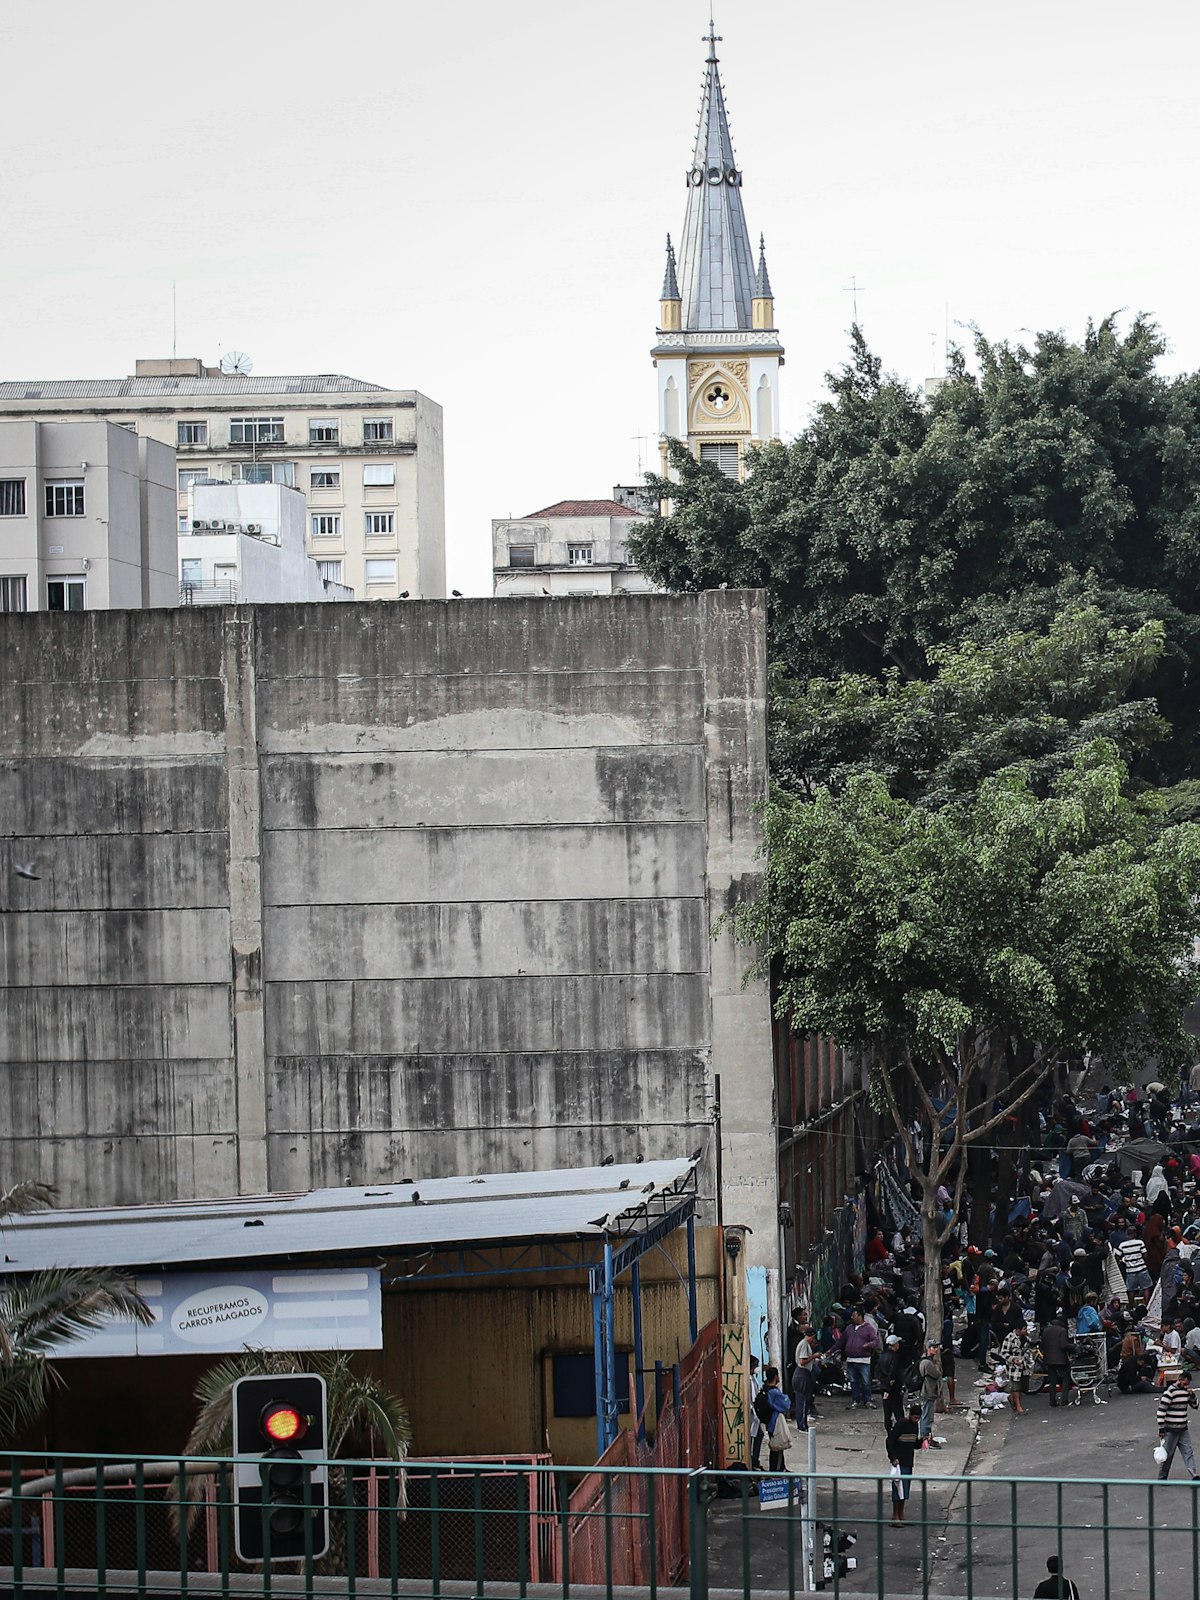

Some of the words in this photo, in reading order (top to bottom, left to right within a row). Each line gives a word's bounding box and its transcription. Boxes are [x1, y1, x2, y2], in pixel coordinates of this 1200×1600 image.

[179, 1317, 213, 1330] CARROS
[215, 1306, 263, 1323] ALAGADOS
[187, 1298, 250, 1318] RECUPERAMOS
